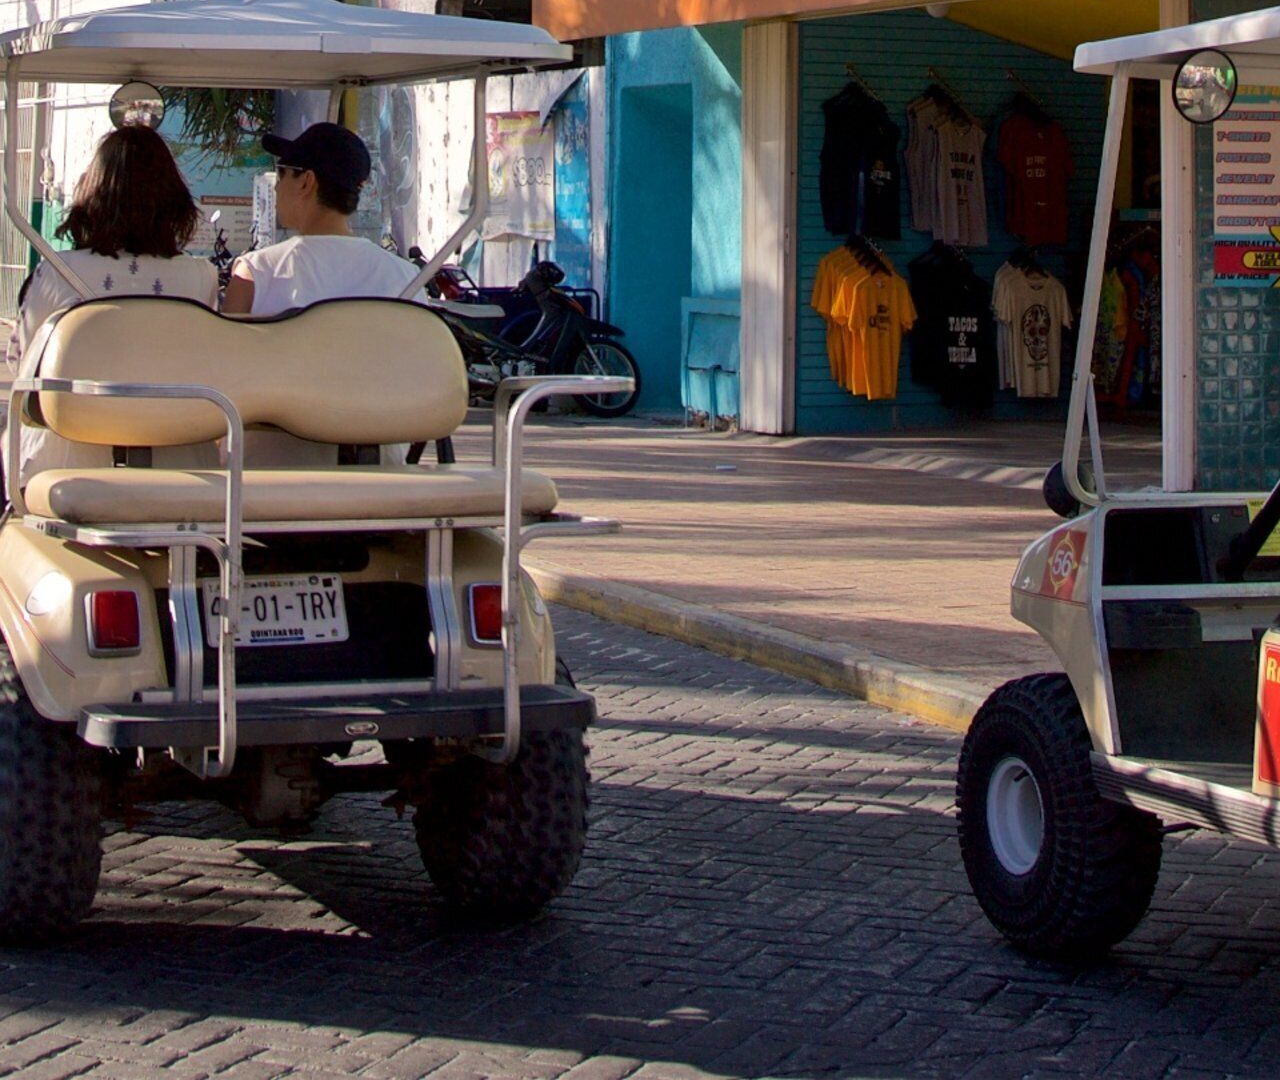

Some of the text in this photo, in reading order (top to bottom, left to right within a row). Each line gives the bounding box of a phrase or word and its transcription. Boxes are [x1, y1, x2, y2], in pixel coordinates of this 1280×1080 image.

[1216, 173, 1275, 184] JEWELRY
[948, 317, 978, 333] TACOS
[958, 333, 967, 346] &
[1052, 549, 1073, 577] 56
[211, 590, 337, 622] 4-01-TRY
[251, 627, 304, 638] QUINTANA ROO
